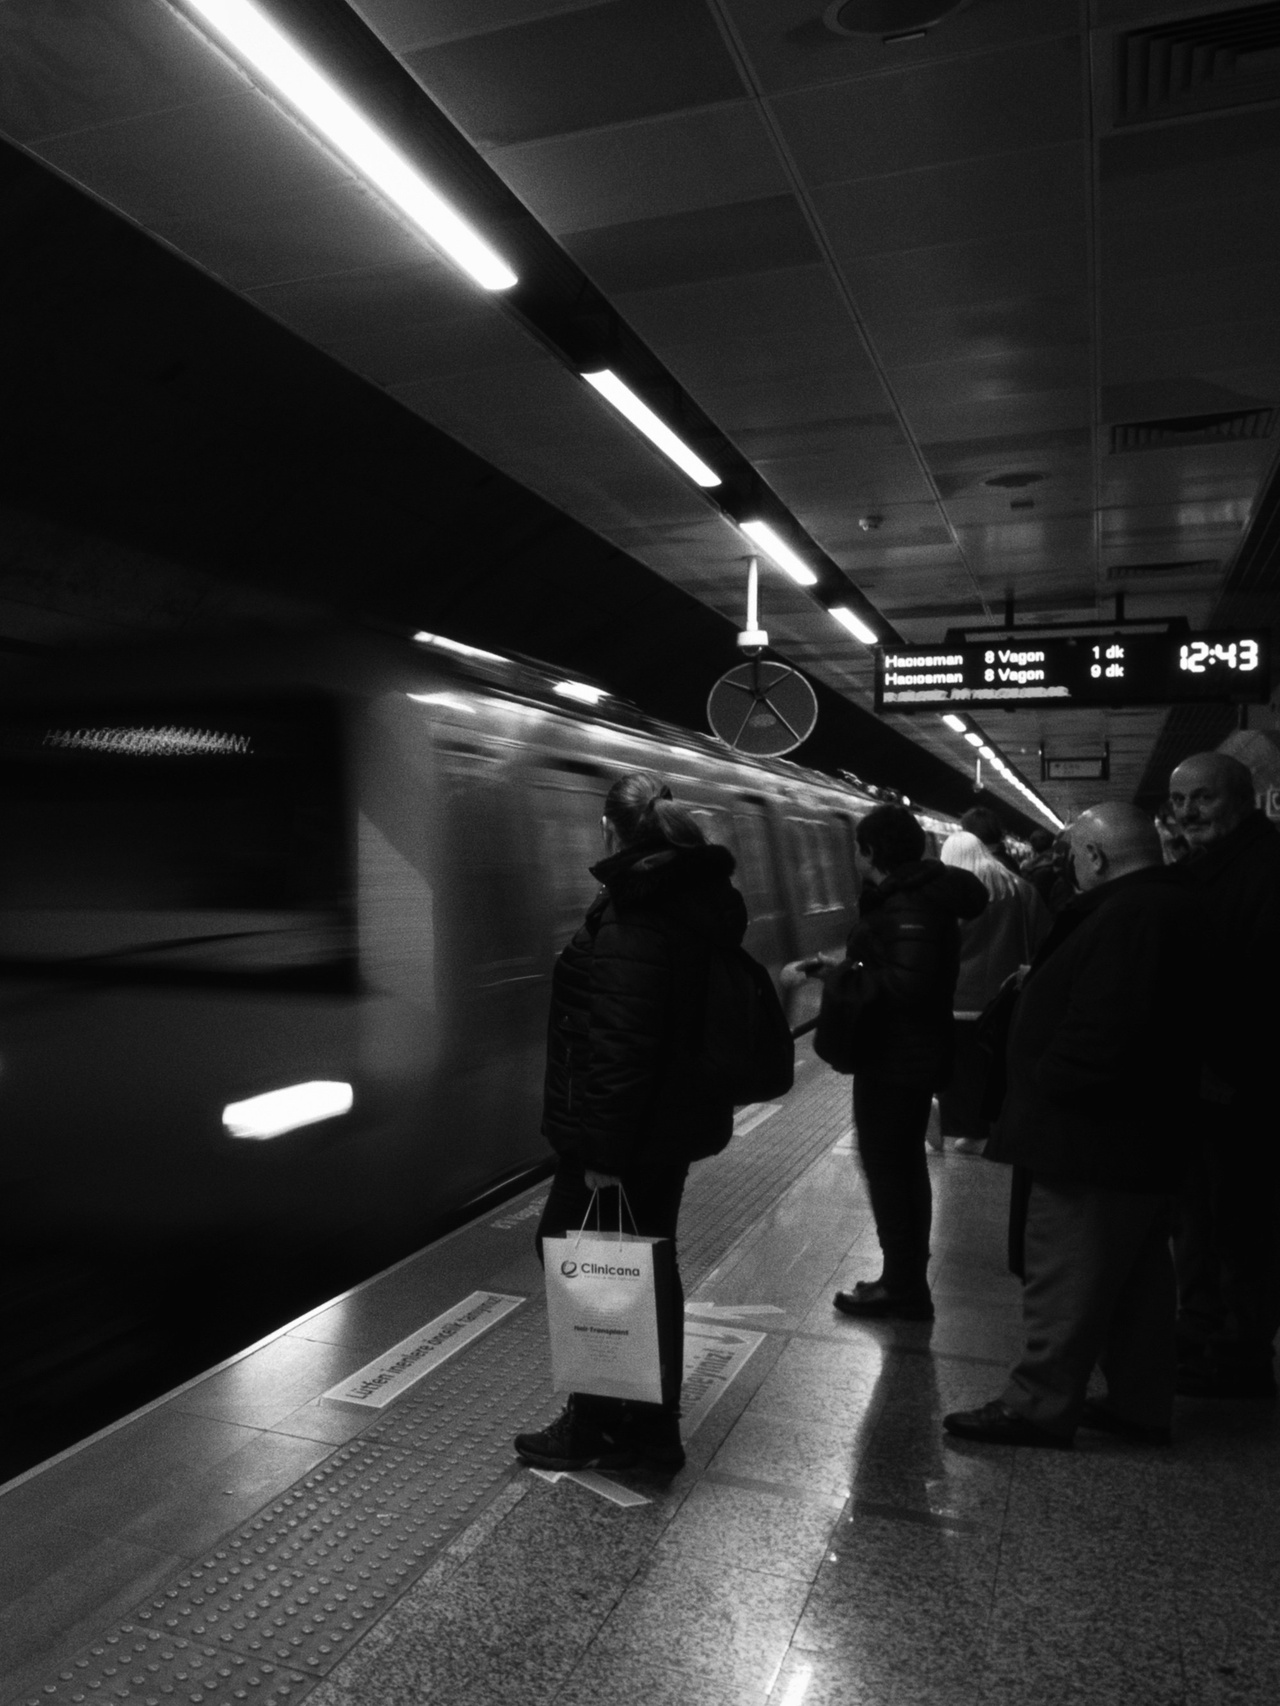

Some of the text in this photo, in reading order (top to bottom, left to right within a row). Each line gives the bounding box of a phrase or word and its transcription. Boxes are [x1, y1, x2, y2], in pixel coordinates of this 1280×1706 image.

[985, 650, 995, 664] 8
[998, 649, 1045, 666] Vagon
[1092, 645, 1100, 660] 1
[1105, 644, 1124, 659] dk
[1180, 640, 1258, 673] 12:43
[984, 668, 995, 682] 8
[998, 667, 1045, 684] Vagon
[1090, 664, 1102, 678] 9
[1105, 663, 1124, 677] dk
[581, 1263, 640, 1277] Clinicana
[345, 1372, 395, 1400] Lütfen
